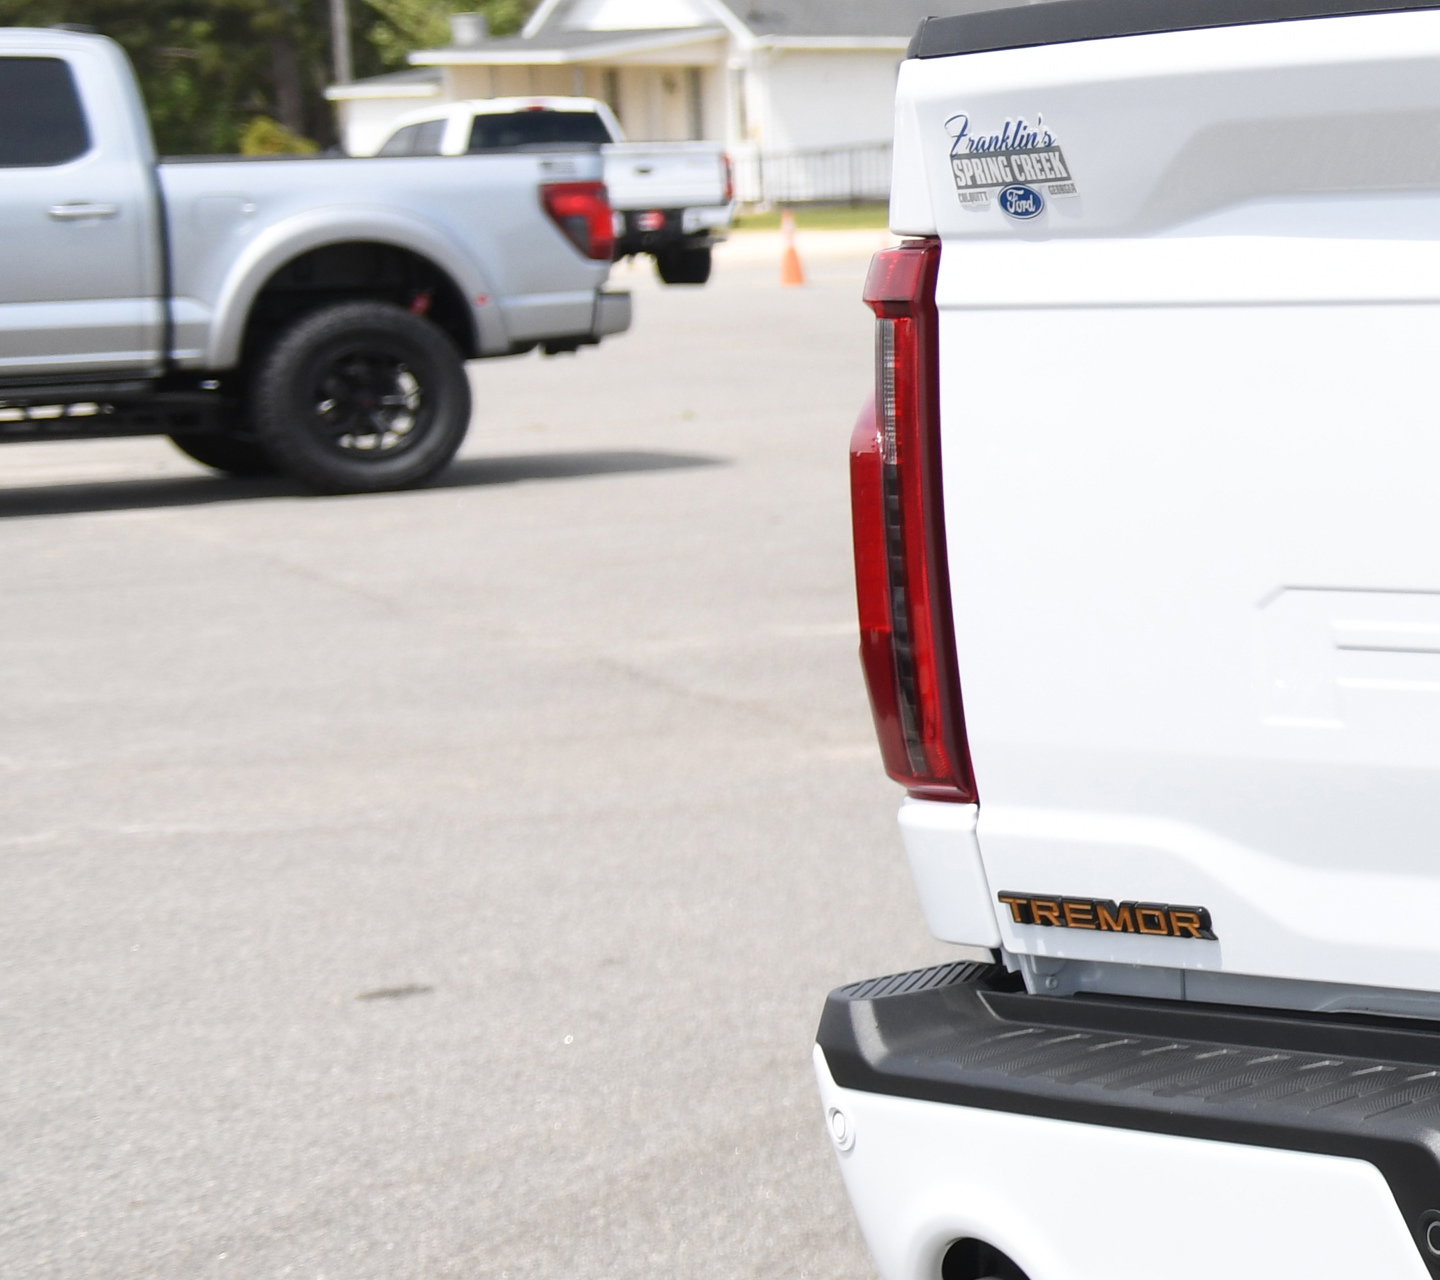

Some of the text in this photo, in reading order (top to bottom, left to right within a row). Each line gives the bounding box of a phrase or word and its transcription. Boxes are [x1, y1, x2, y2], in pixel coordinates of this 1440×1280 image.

[944, 115, 1055, 157] Franklin's
[953, 151, 1068, 187] SPRING CREEK
[1006, 189, 1036, 214] Ford
[998, 891, 1217, 940] TREMOR
